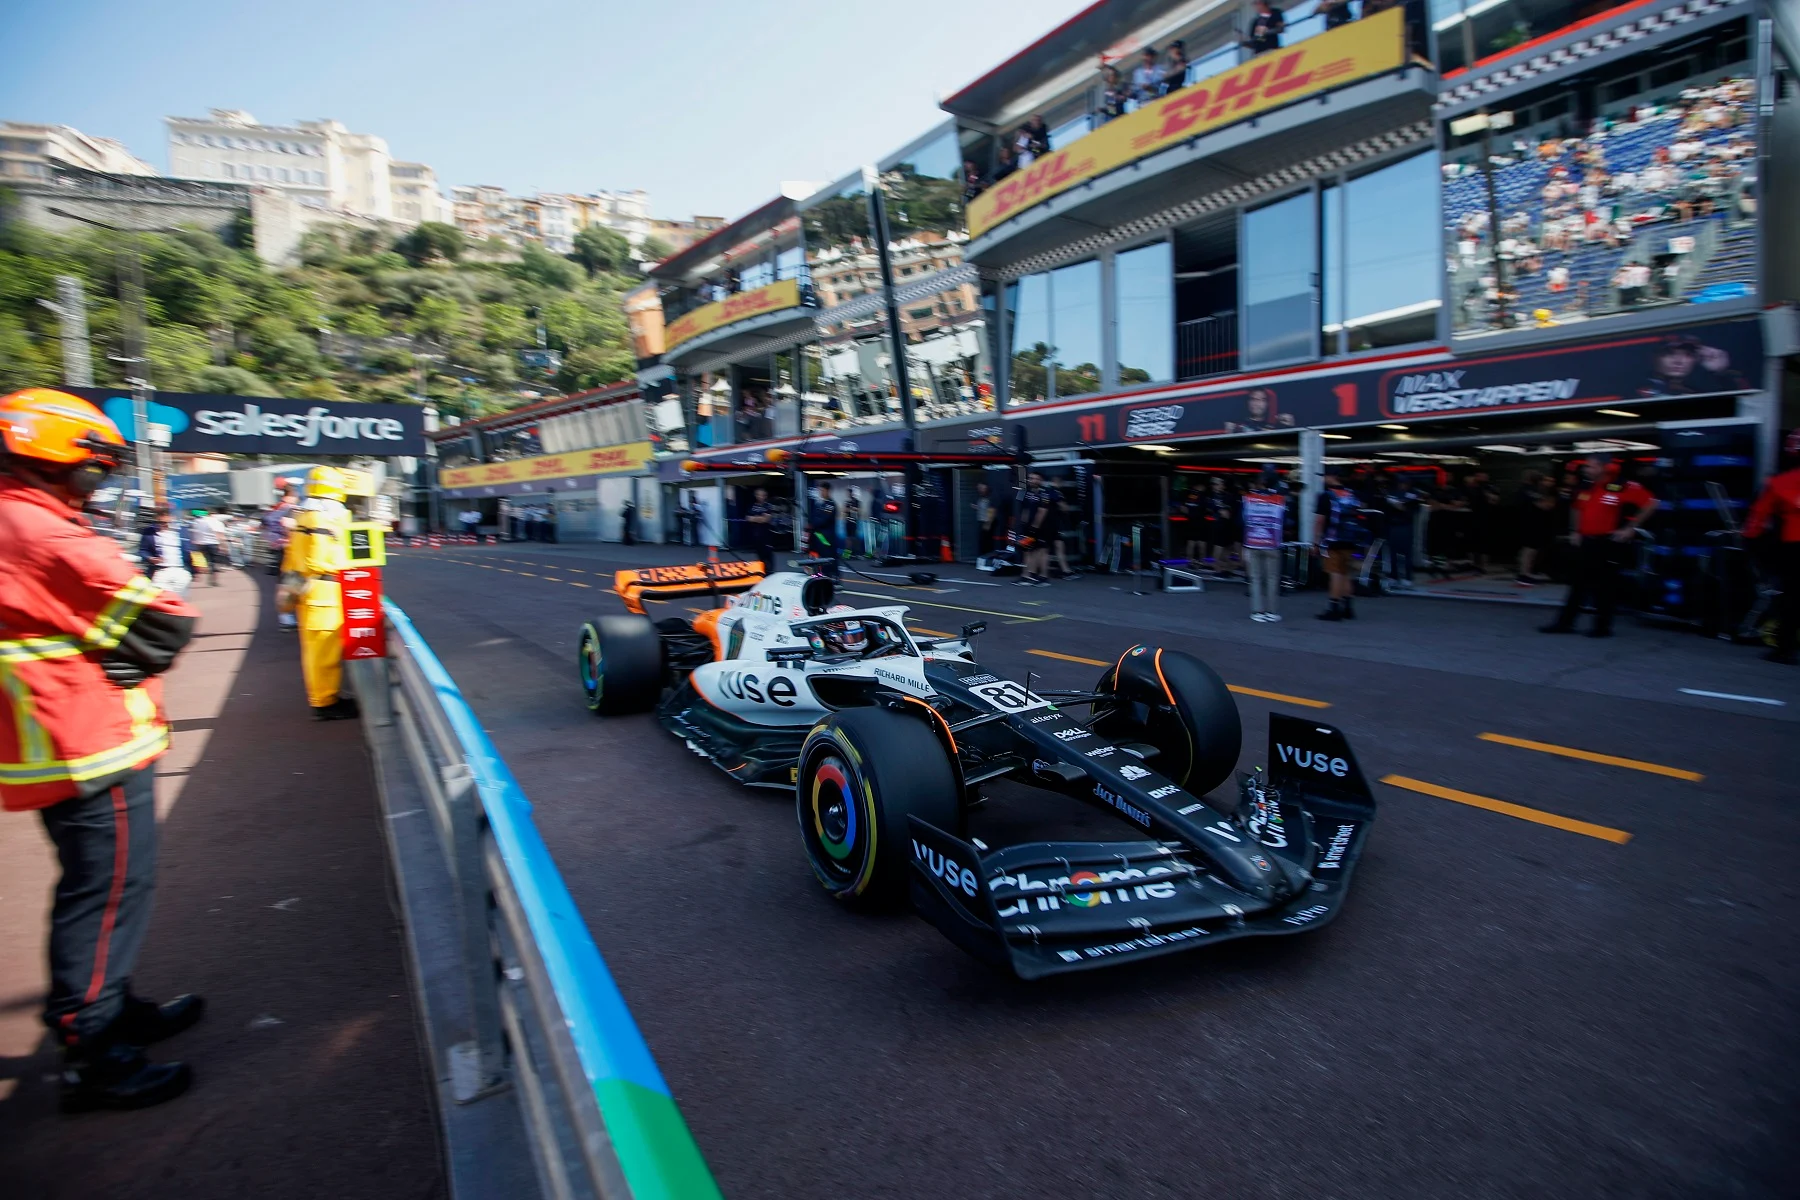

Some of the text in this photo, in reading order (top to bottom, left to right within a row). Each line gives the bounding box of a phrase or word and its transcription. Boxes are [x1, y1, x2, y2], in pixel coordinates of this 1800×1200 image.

[1158, 50, 1314, 139] DHL
[989, 152, 1078, 216] DHL
[1393, 378, 1580, 414] VERSTAPPEN
[1395, 370, 1467, 394] MAX
[1332, 382, 1358, 417] 1
[195, 403, 404, 447] salesforce
[1076, 413, 1106, 442] 11
[873, 667, 930, 693] RICHARD MILLE
[979, 683, 1043, 709] 81
[1030, 712, 1064, 725] alteryx
[1083, 925, 1212, 959] smartsheet
